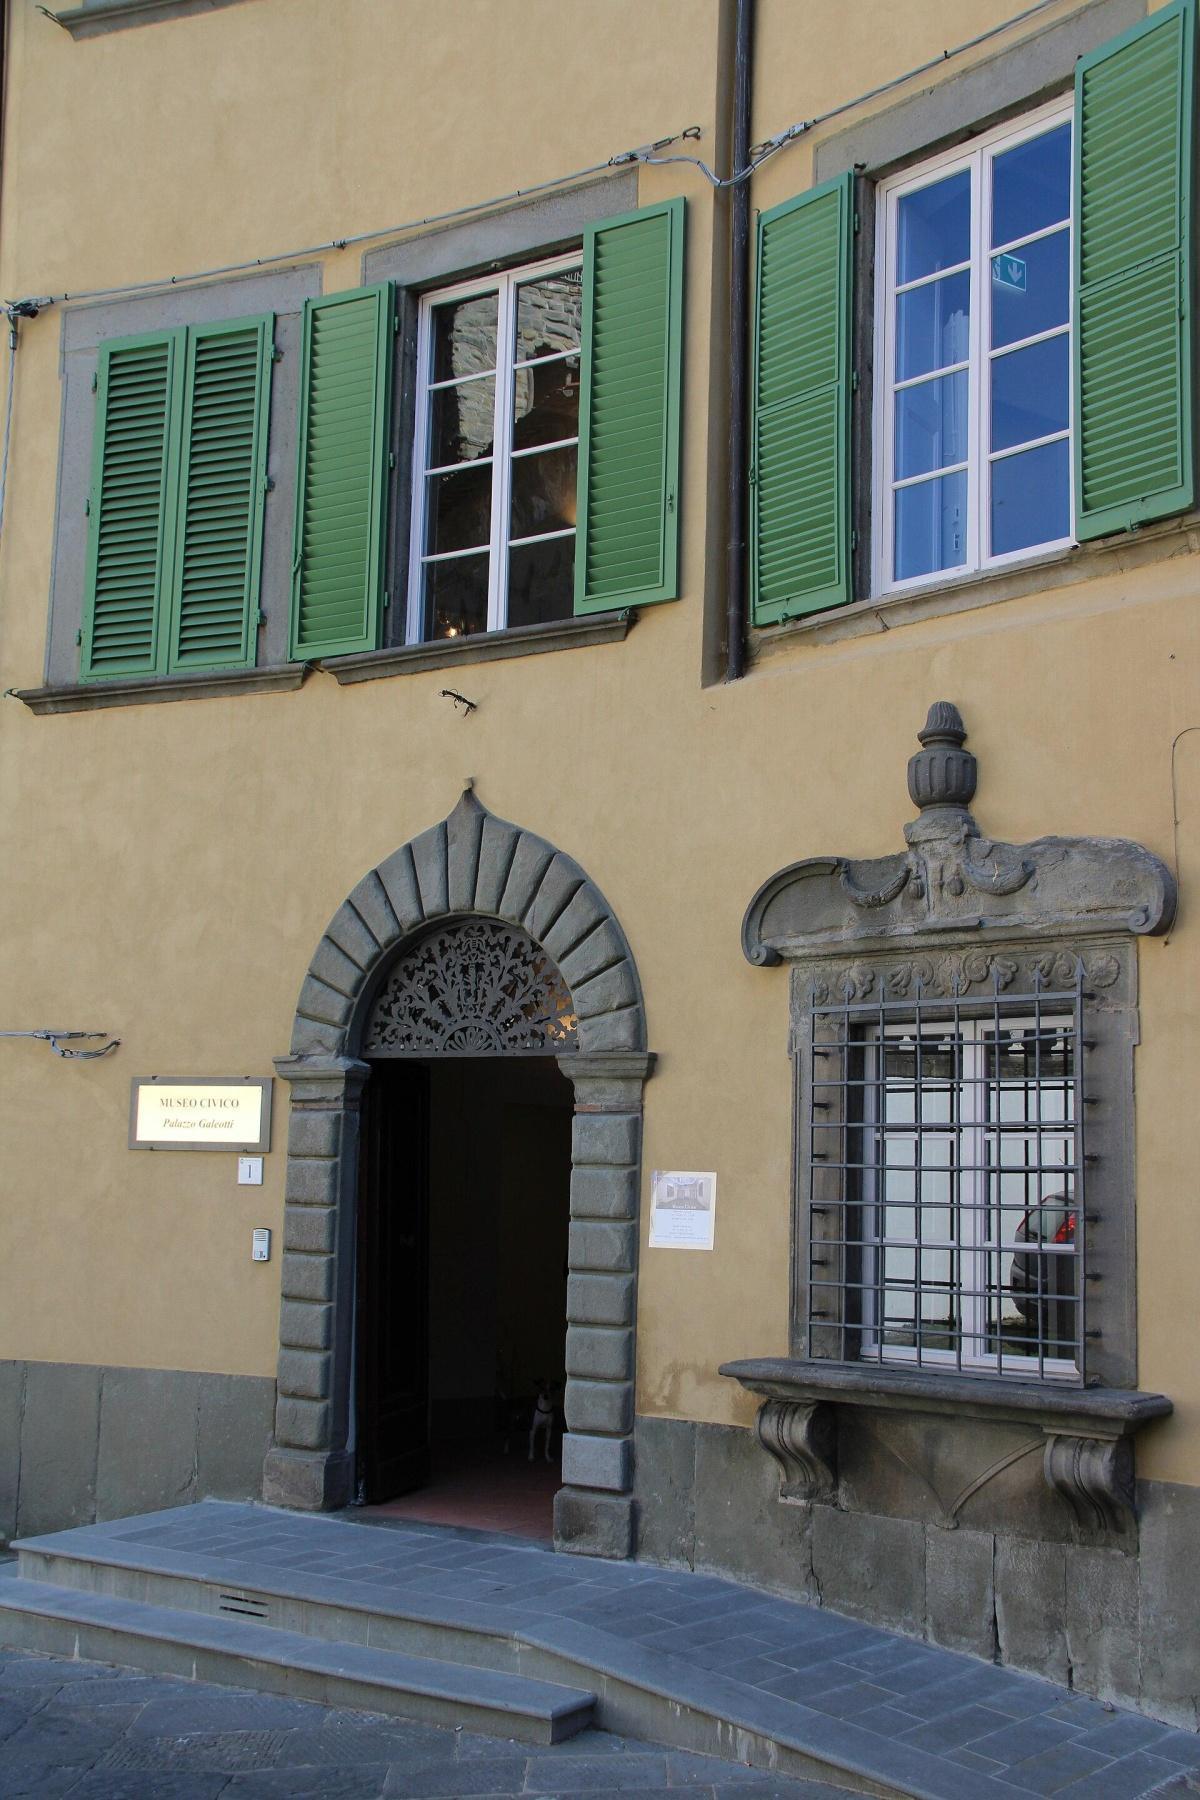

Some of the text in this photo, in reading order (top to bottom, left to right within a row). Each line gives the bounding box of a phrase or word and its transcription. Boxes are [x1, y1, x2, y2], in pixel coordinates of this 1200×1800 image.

[160, 1098, 239, 1108] MUSEO CIVICO
[163, 1118, 196, 1129] Palazzo
